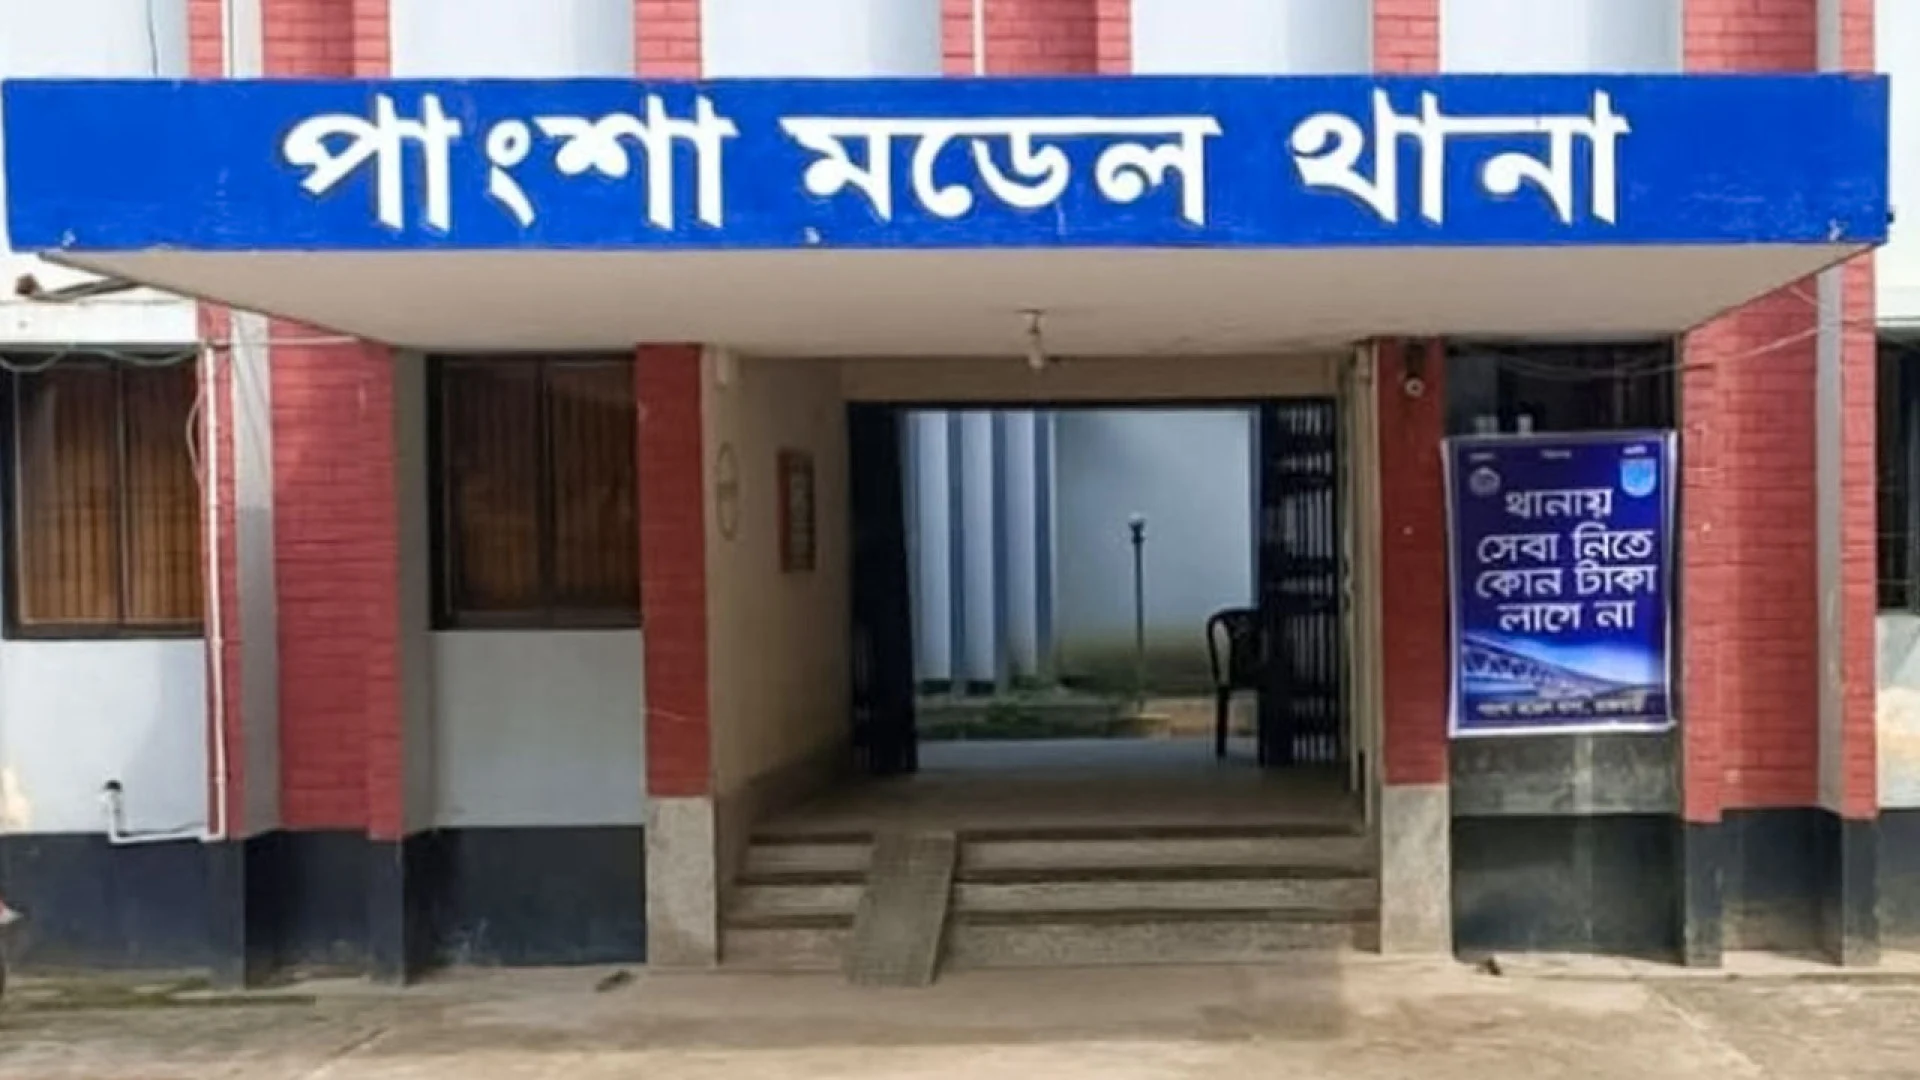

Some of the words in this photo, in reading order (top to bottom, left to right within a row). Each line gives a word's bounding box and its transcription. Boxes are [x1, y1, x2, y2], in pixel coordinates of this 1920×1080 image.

[282, 92, 739, 231] পাংশা
[780, 115, 1222, 226] মডেল
[1291, 88, 1630, 225] থানা
[1505, 487, 1613, 519] থানায়
[1477, 533, 1560, 563] সেবা
[1570, 521, 1654, 562] নিতে
[1476, 568, 1563, 598] কোন
[1574, 559, 1657, 594] টাকা
[1497, 602, 1582, 631] লাগে
[1593, 600, 1636, 628] না
